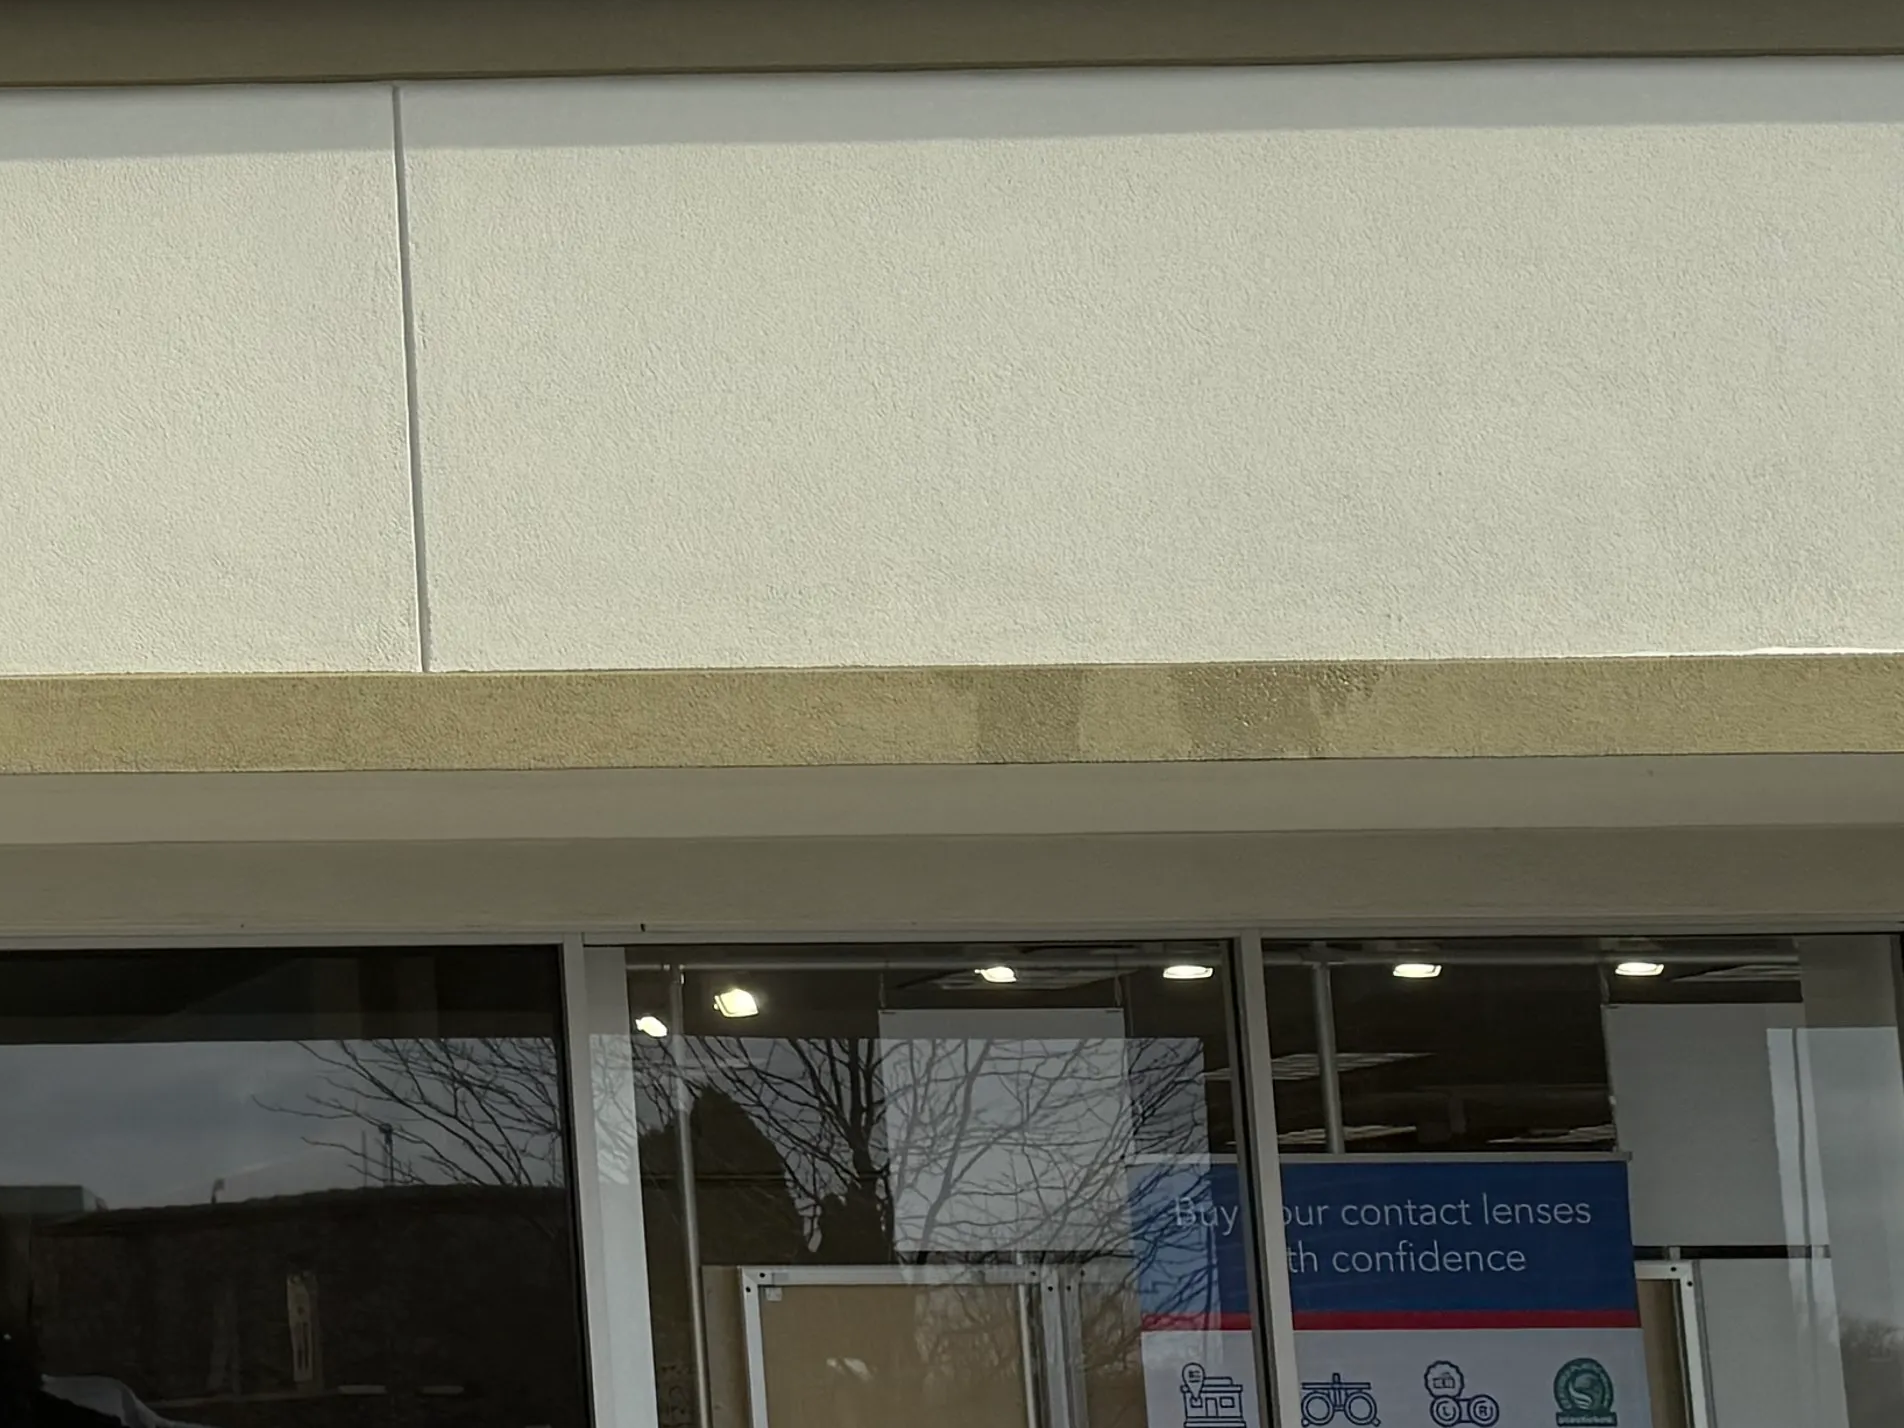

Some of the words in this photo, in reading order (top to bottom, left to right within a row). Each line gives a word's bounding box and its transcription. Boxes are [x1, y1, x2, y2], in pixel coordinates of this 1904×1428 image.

[1176, 1197, 1239, 1237] Buy
[1282, 1205, 1329, 1227] our
[1340, 1197, 1472, 1227] contact
[1482, 1192, 1592, 1226] lenses
[1286, 1239, 1319, 1274] th
[1331, 1241, 1527, 1275] confidence
